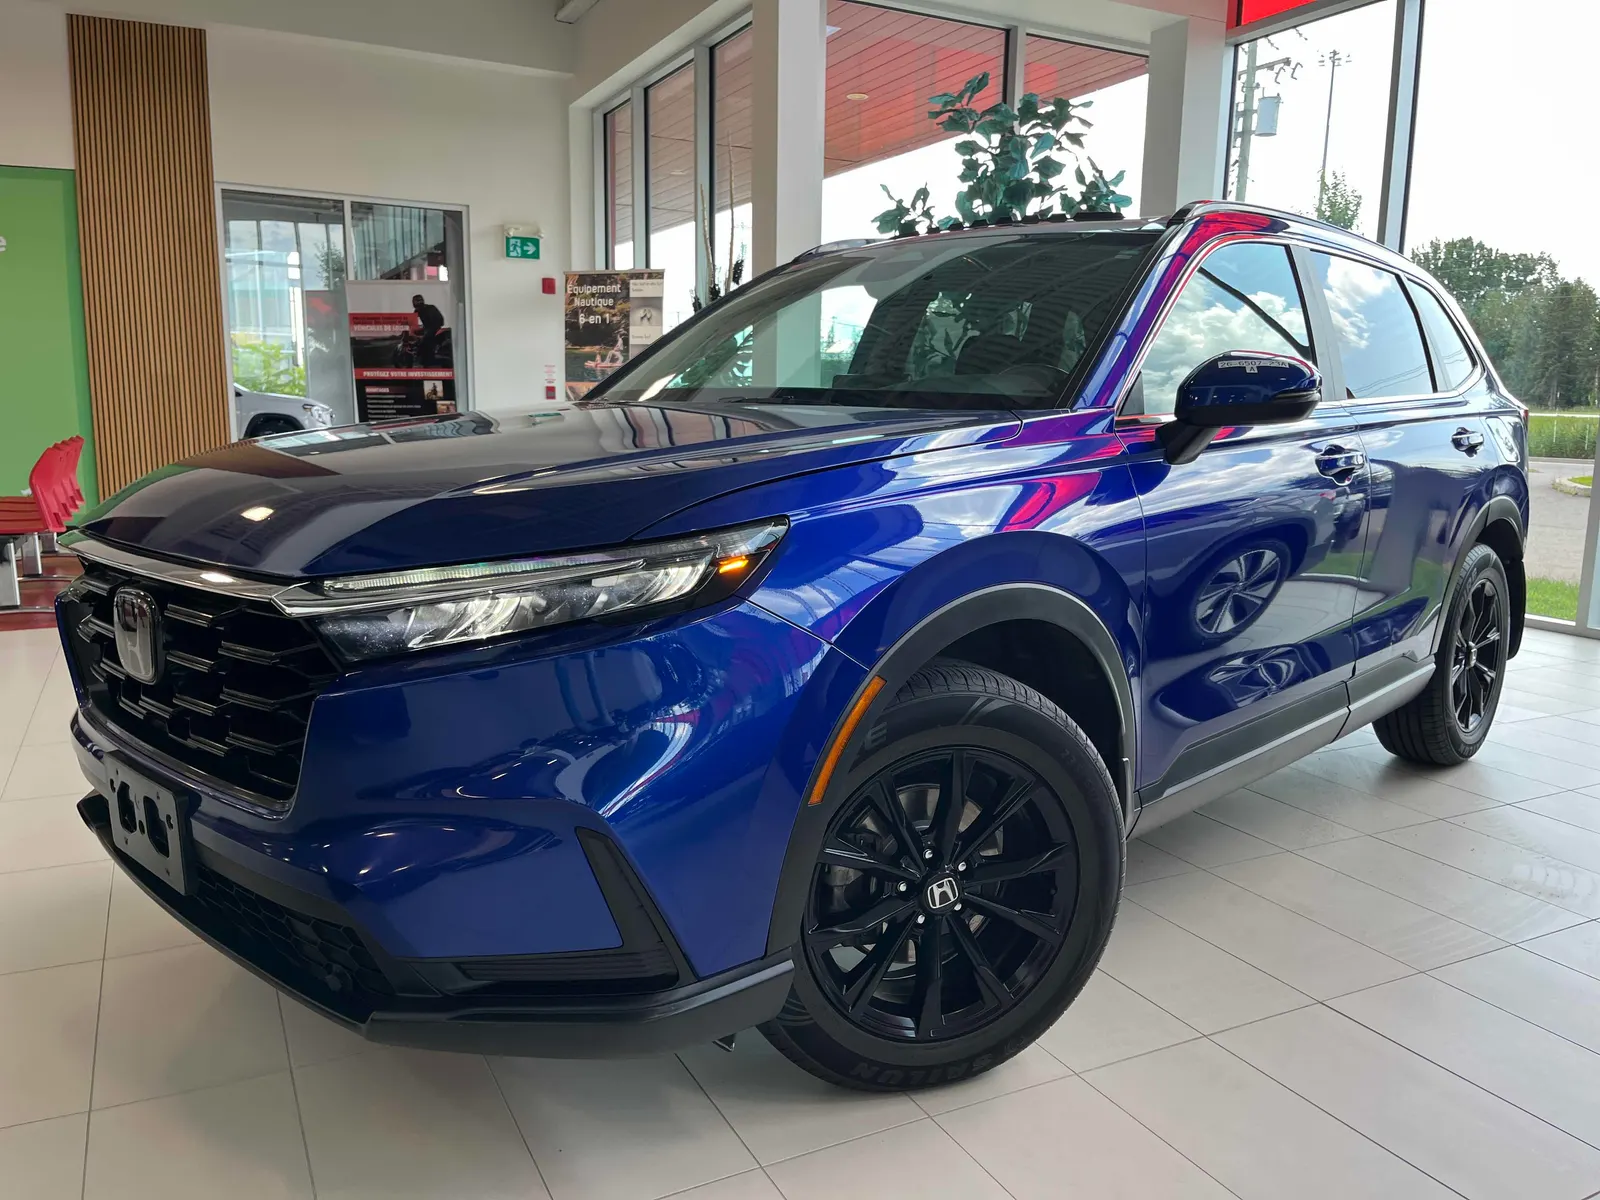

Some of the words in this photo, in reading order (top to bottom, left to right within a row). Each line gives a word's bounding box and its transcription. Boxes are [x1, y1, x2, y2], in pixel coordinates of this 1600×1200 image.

[574, 297, 614, 307] Nautique
[579, 314, 586, 324] 6
[589, 315, 602, 324] en
